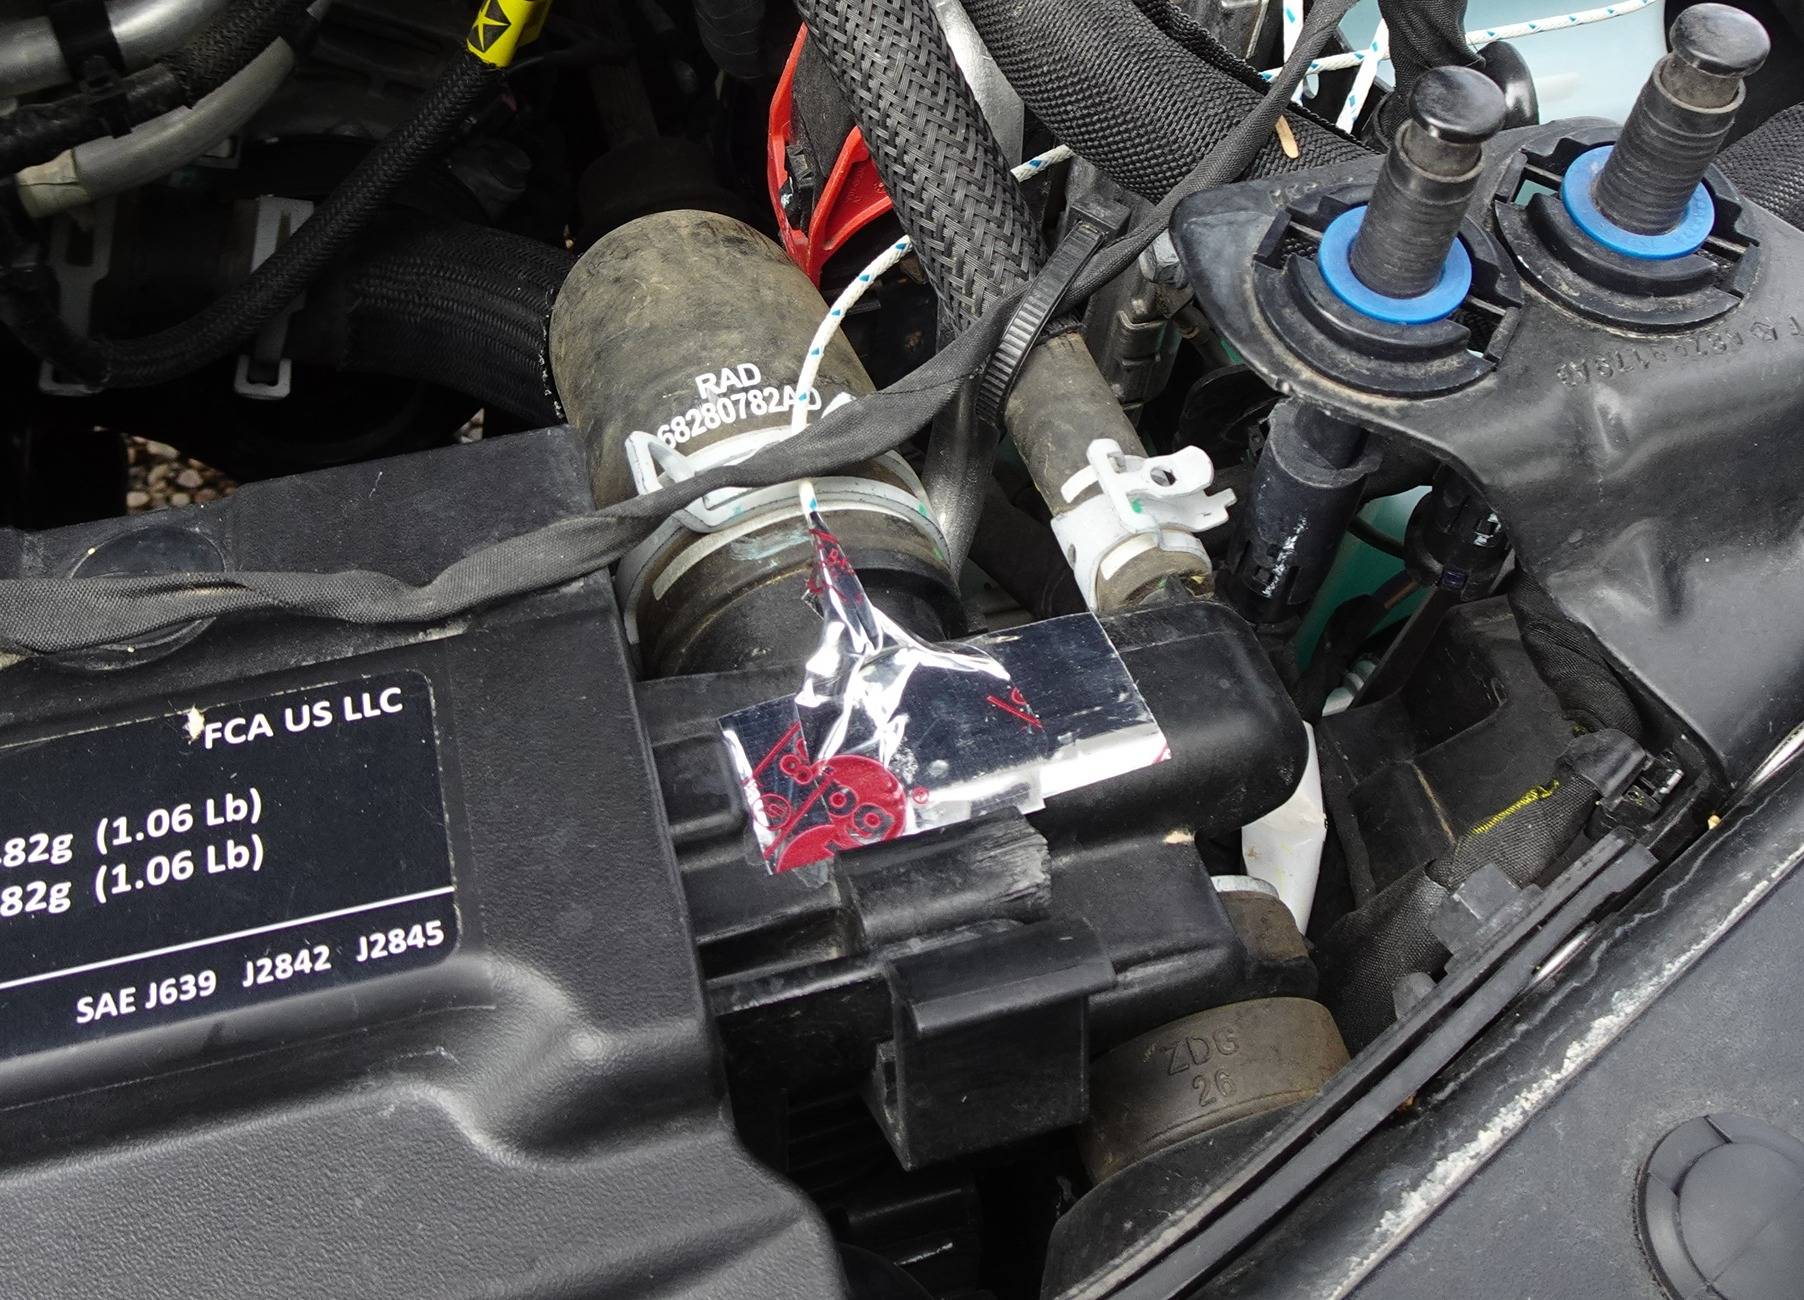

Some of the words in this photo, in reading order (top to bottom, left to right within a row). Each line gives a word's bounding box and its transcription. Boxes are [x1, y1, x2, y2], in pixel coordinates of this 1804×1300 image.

[695, 363, 761, 399] RAD
[657, 385, 822, 450] 68280782AD
[204, 714, 273, 749] FCA
[285, 701, 332, 732] US
[344, 687, 403, 721] LLC
[0, 832, 73, 867] 82g
[96, 804, 194, 855] (1.06
[206, 788, 261, 826] Lb)
[94, 850, 195, 903] (1.06
[207, 834, 263, 873] Lb)
[77, 987, 136, 1023] SAE
[145, 970, 216, 1009] J639
[243, 944, 331, 987] J2842
[356, 920, 444, 962] J2845
[1192, 1068, 1236, 1107] 26
